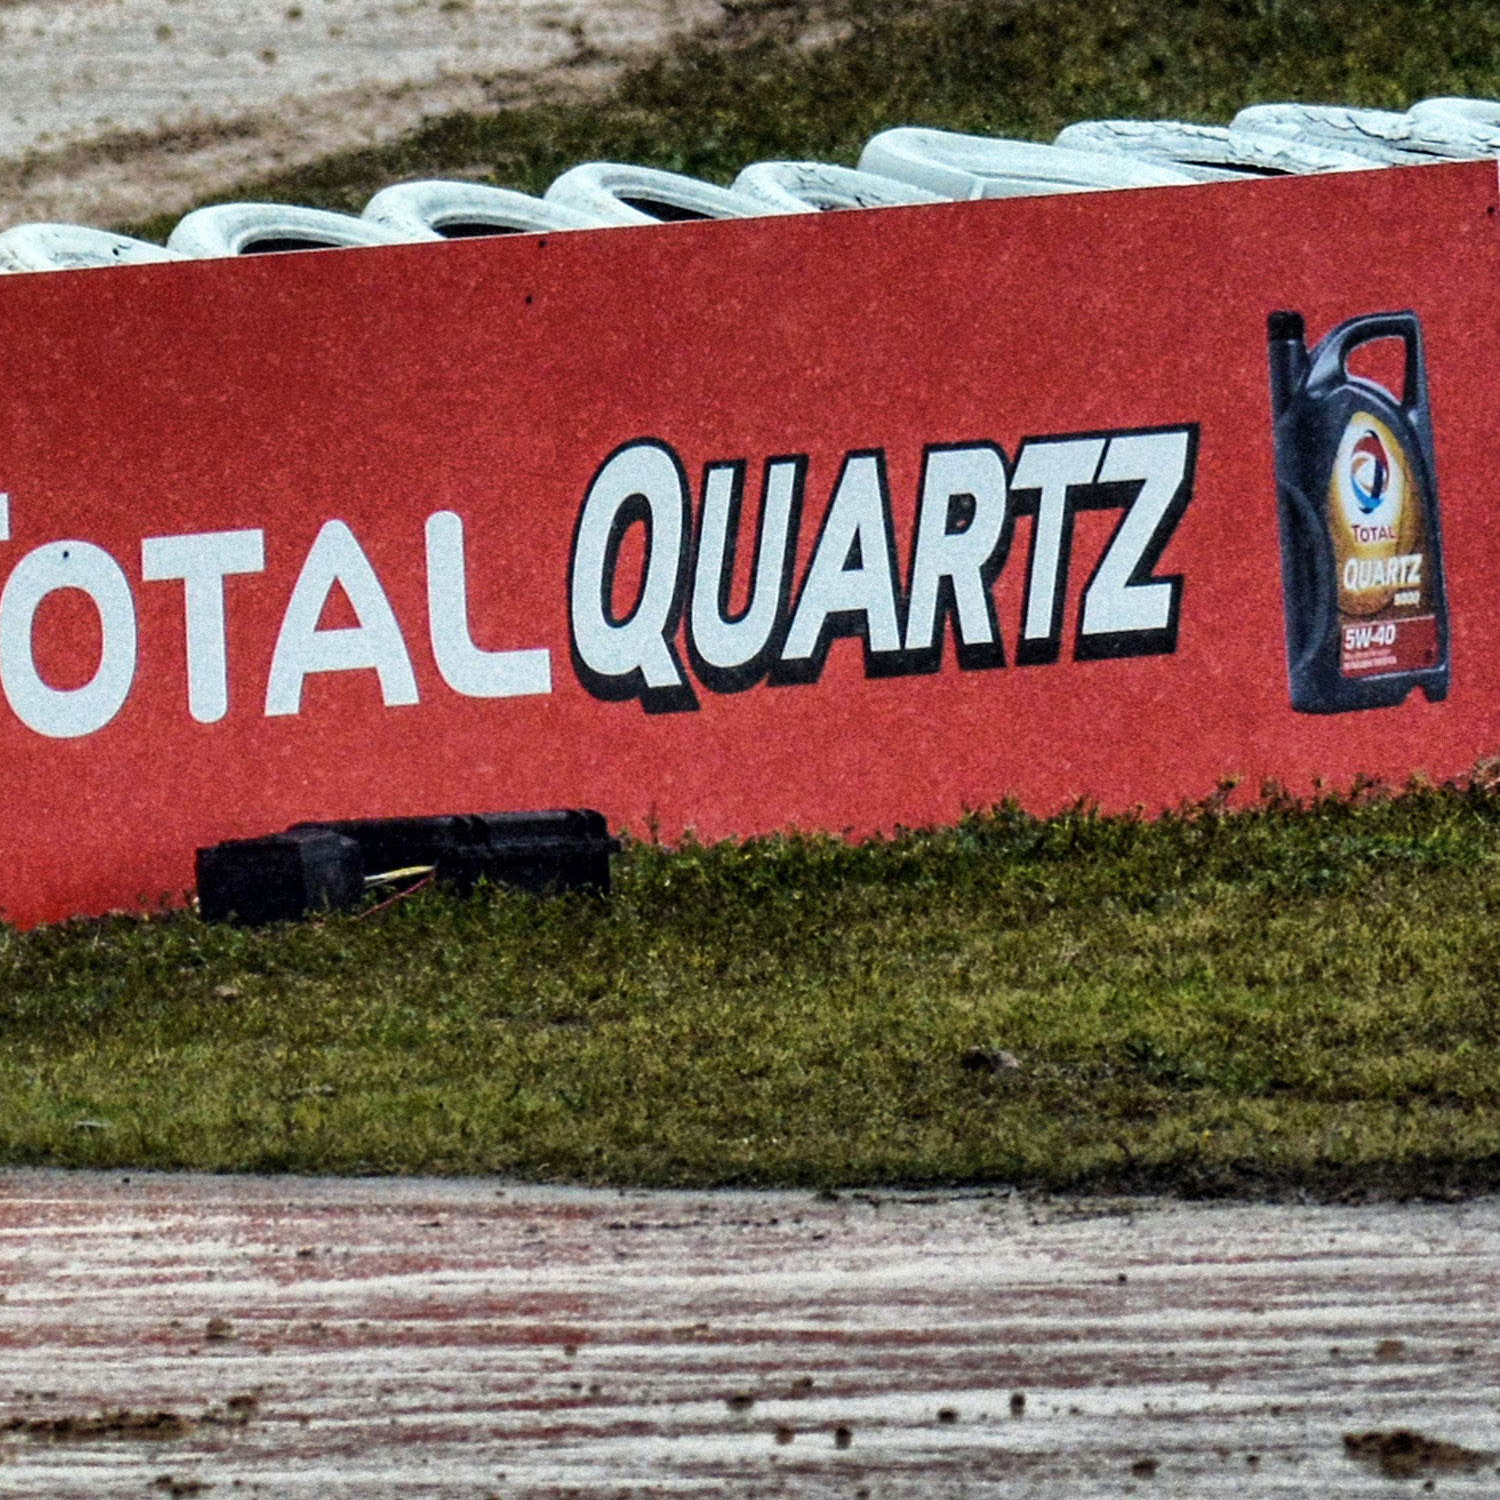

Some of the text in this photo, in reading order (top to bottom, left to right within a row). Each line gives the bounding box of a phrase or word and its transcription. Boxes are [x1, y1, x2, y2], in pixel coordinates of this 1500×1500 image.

[1351, 524, 1397, 543] TOTAL
[567, 422, 1200, 714] QUARTZ
[1343, 553, 1423, 594] QUARTZ
[1345, 623, 1397, 650] 5W-40
